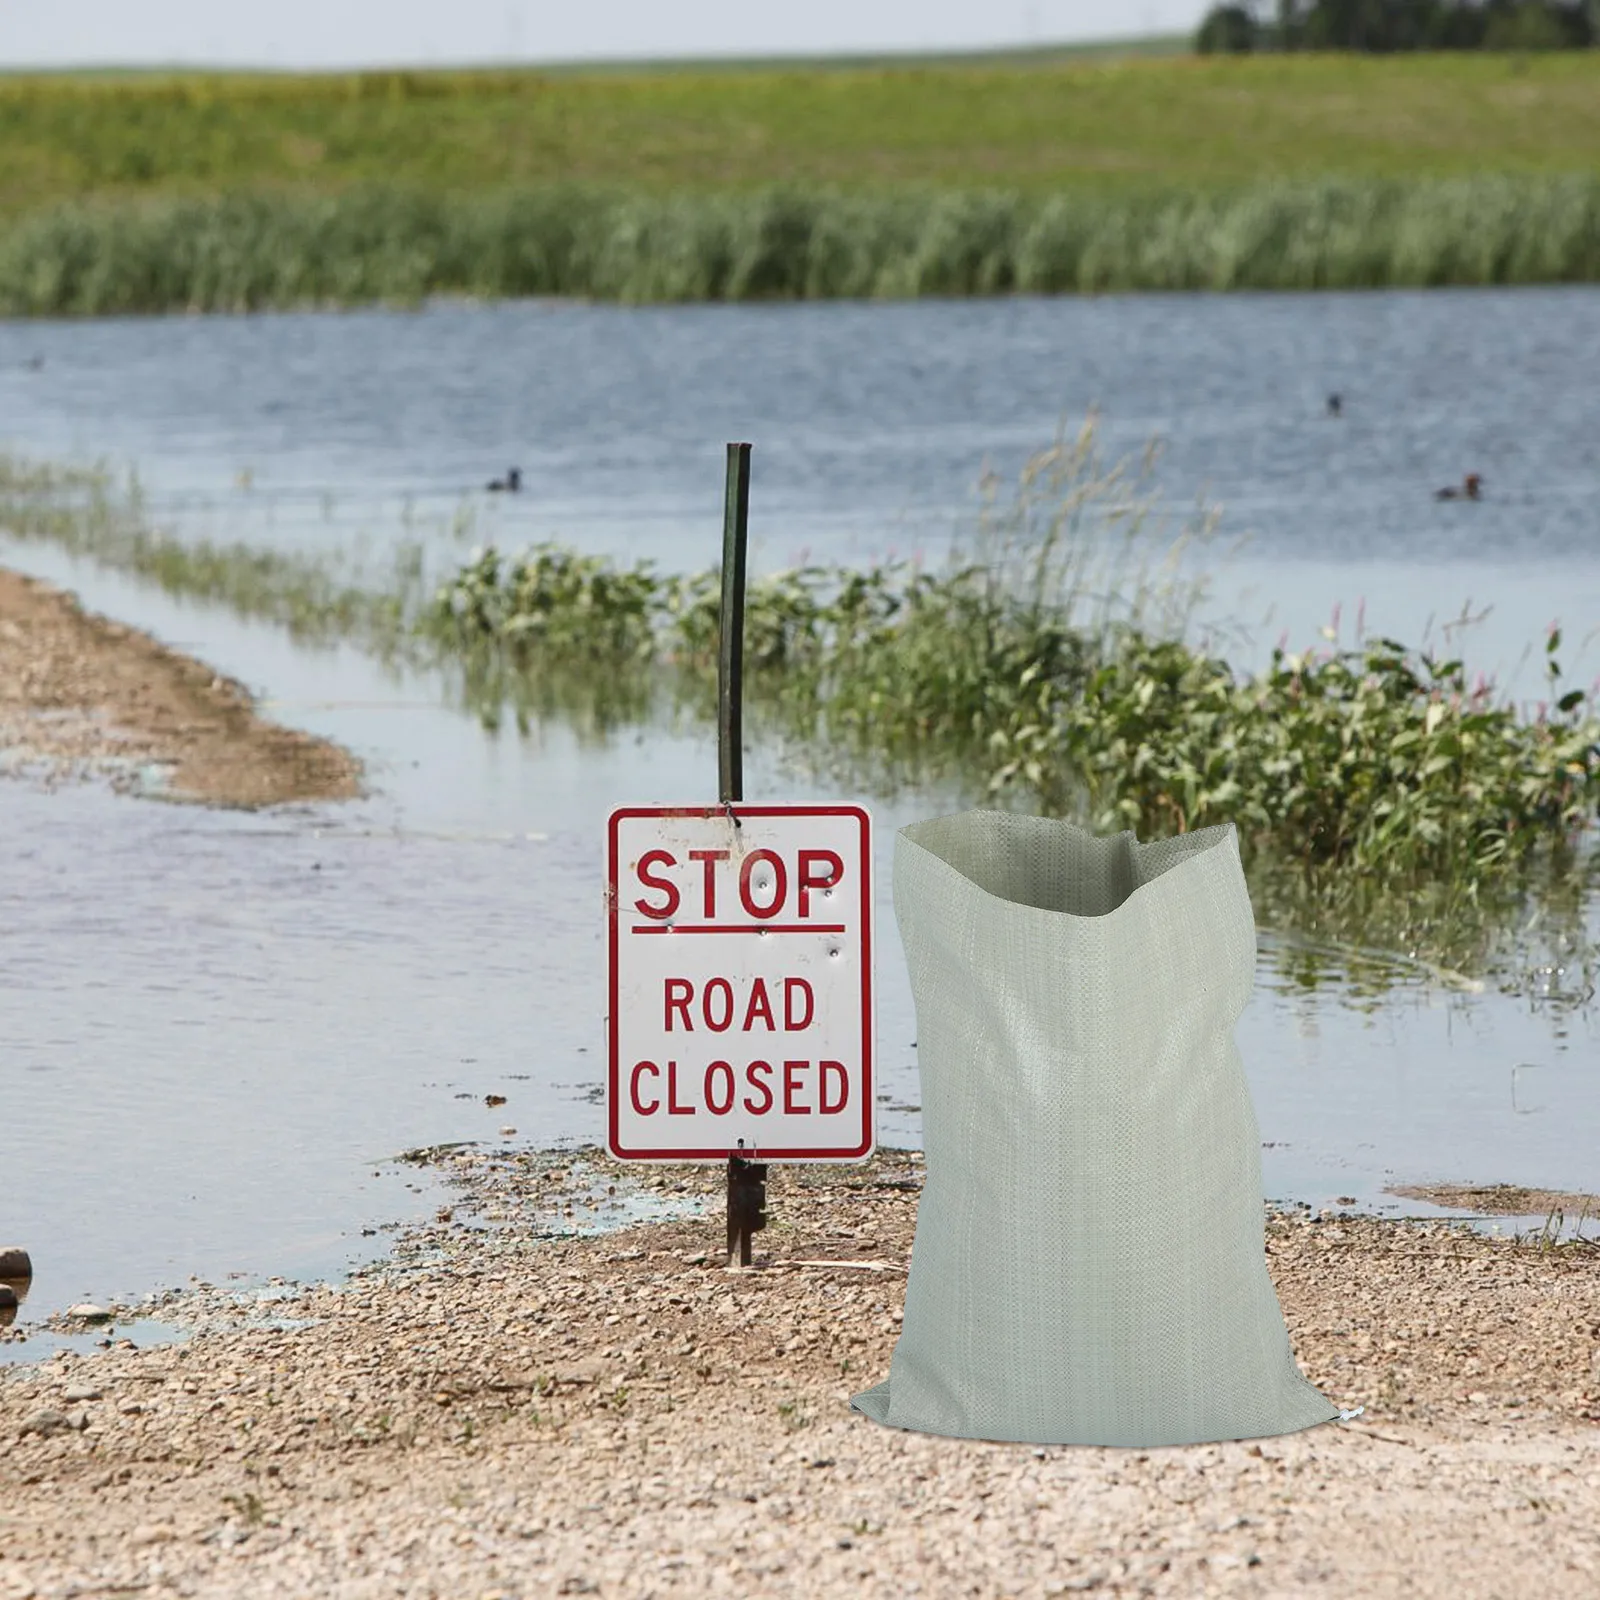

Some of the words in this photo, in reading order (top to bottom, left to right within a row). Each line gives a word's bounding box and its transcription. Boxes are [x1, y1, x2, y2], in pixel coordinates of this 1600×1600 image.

[634, 848, 845, 920] STOP
[664, 977, 815, 1032] ROAD
[630, 1060, 849, 1116] CLOSED
